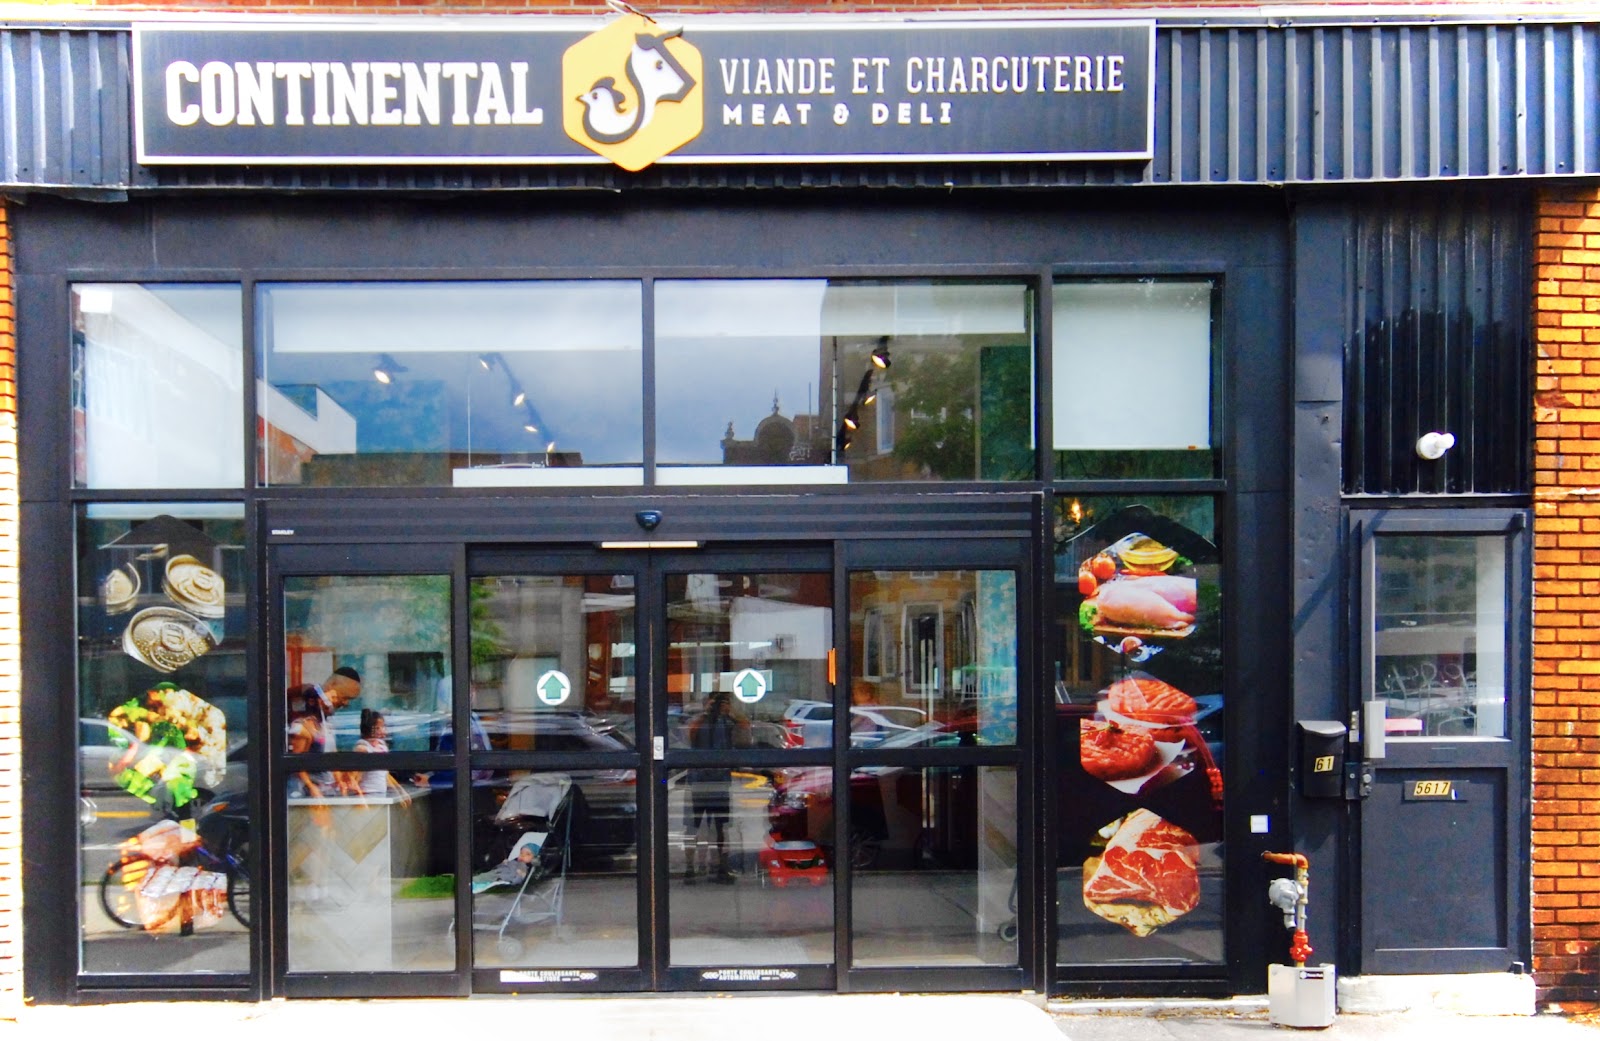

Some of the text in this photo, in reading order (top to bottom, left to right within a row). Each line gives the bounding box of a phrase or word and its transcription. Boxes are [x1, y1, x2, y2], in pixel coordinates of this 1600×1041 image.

[719, 54, 1125, 95] VIANDE ET CHARCUTERIE
[165, 61, 543, 126] CONTINENTAL
[722, 102, 953, 125] MEAT & DELI
[1315, 757, 1333, 770] 61
[1415, 781, 1449, 794] 5617
